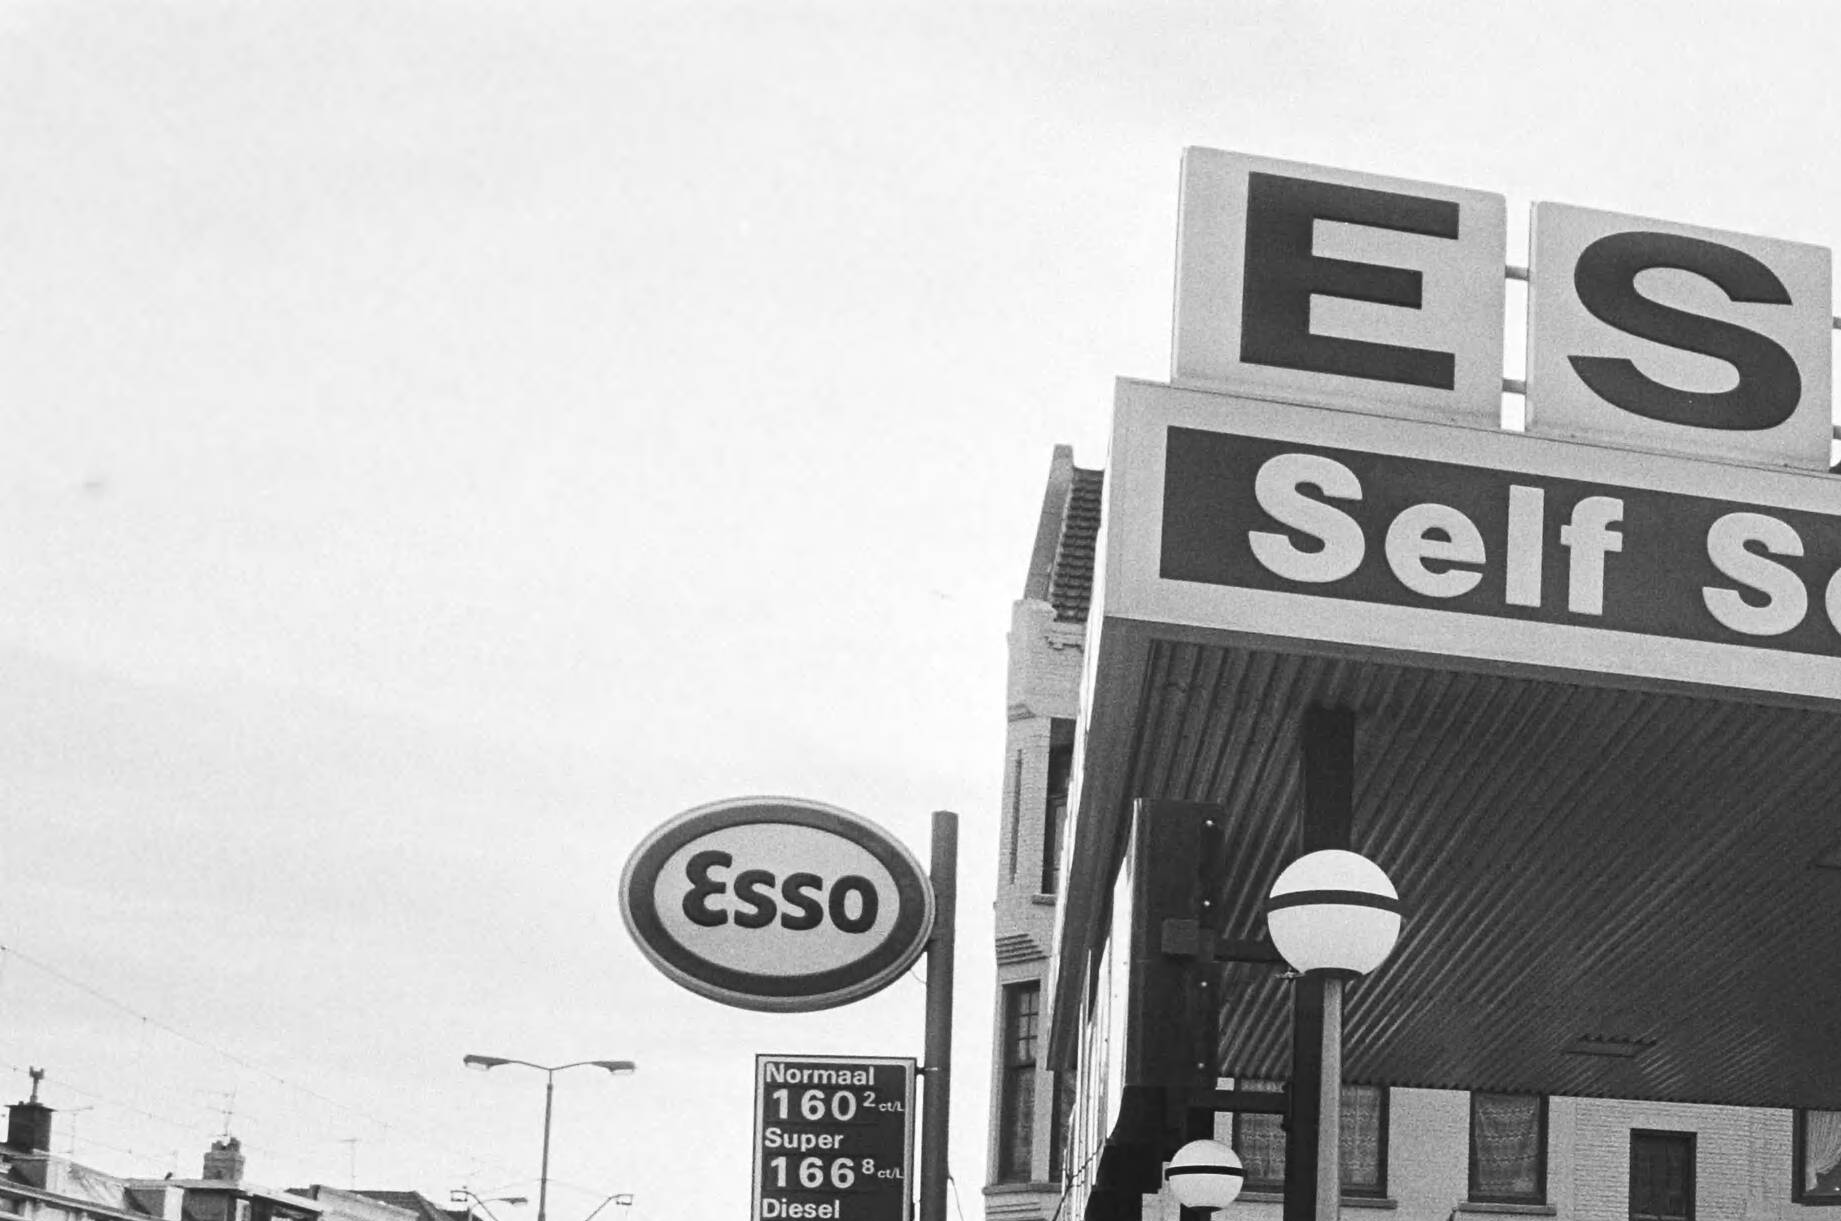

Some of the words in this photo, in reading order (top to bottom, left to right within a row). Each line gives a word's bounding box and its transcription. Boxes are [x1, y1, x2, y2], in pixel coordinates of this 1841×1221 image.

[1248, 453, 1624, 615] Self
[766, 1062, 875, 1086] Normaal
[764, 1127, 844, 1152] Super
[762, 1197, 840, 1219] Diesel
